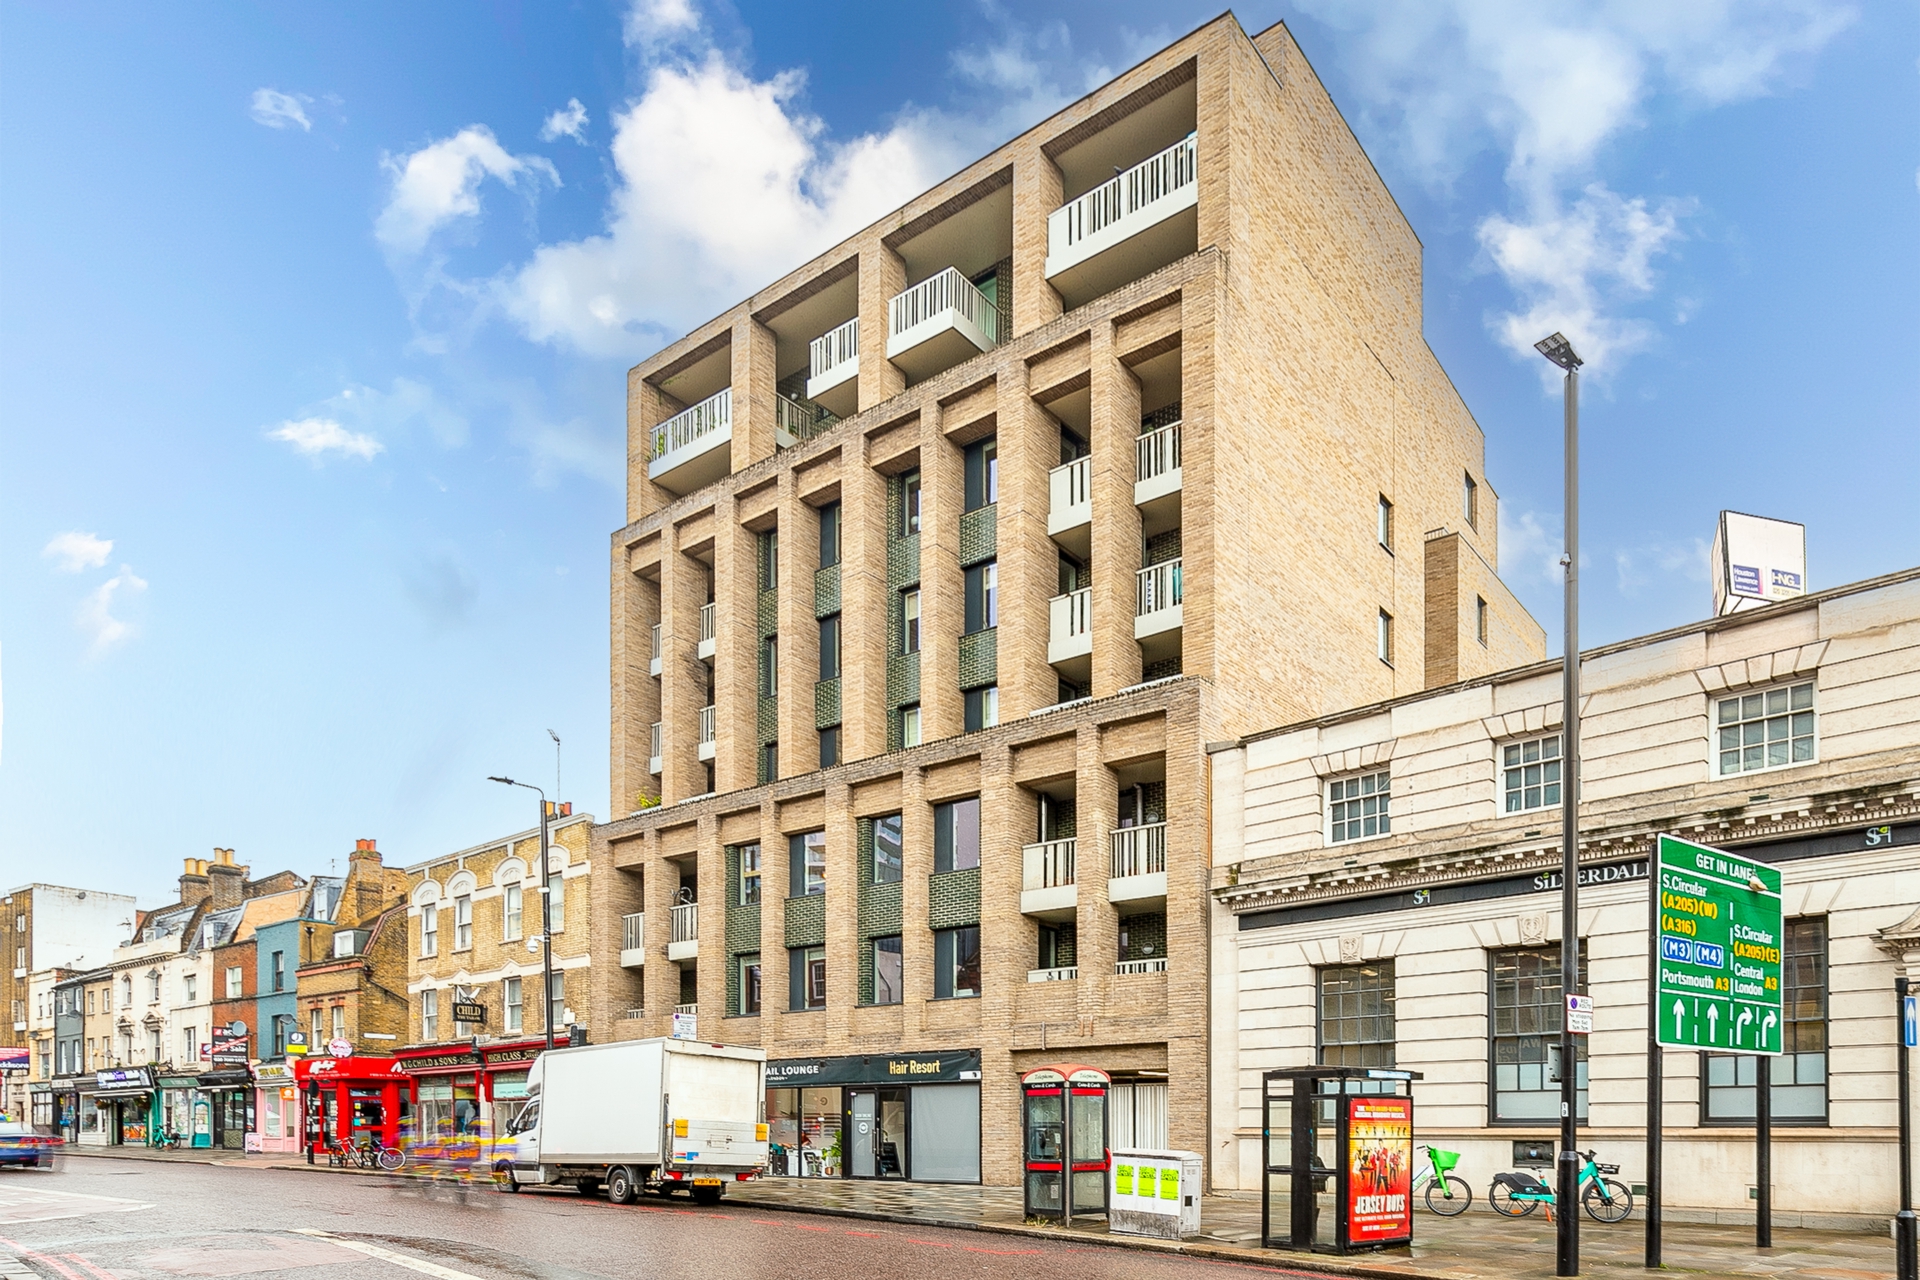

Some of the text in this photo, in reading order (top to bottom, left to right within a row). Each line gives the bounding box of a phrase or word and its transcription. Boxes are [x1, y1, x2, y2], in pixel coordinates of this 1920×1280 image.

[1772, 572, 1795, 586] HNG
[1696, 853, 1753, 880] GET IN LANE
[1662, 873, 1708, 897] S.Circular
[1662, 914, 1697, 936] (A316)
[1734, 924, 1773, 944] S.Circular
[1663, 937, 1722, 966] (M3) (M4)
[1662, 968, 1729, 991] Portsmouth A3
[1734, 962, 1764, 981] Central
[1734, 979, 1764, 997] London
[1764, 975, 1777, 991] A3
[456, 1005, 481, 1016] CHILD
[439, 1056, 459, 1065] SONS
[487, 1052, 502, 1063] HIGH
[502, 1051, 522, 1061] CLASS
[765, 1065, 819, 1076] AIL LOUNGE
[889, 1059, 941, 1075] Hair Resort
[1354, 1193, 1406, 1214] JERSEY BOYS
